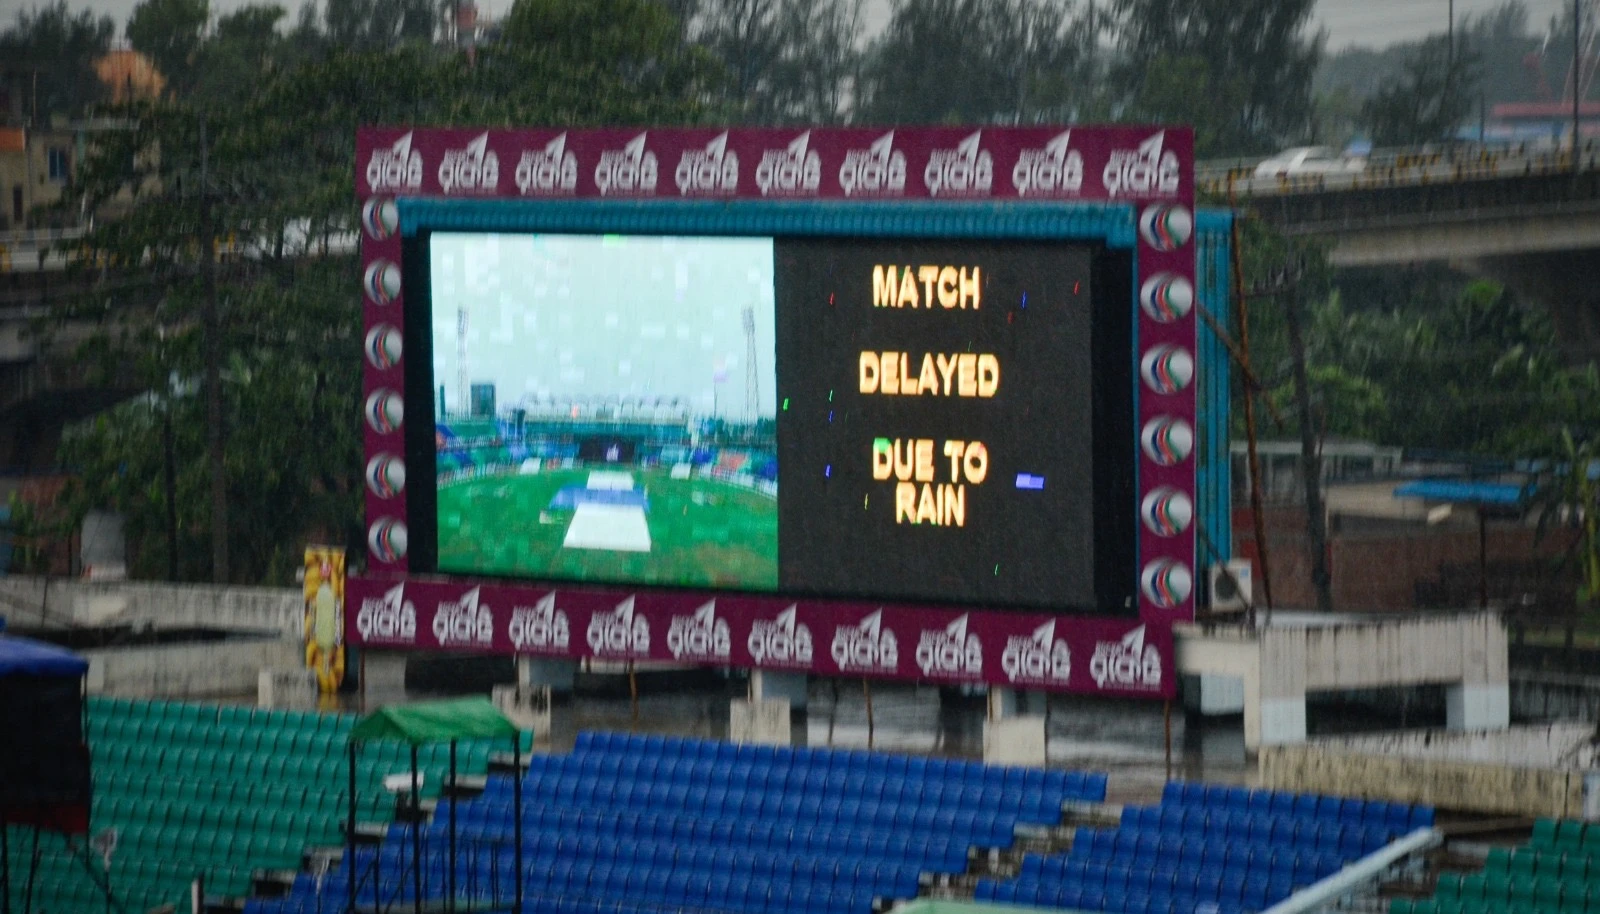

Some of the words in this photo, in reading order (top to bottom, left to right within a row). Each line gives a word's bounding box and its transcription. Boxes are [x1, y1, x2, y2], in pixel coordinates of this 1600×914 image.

[872, 264, 981, 310] MATCH
[858, 351, 1000, 398] DELAYED
[872, 437, 934, 483] DUE
[943, 439, 989, 485] TO
[895, 482, 966, 528] RAIN
